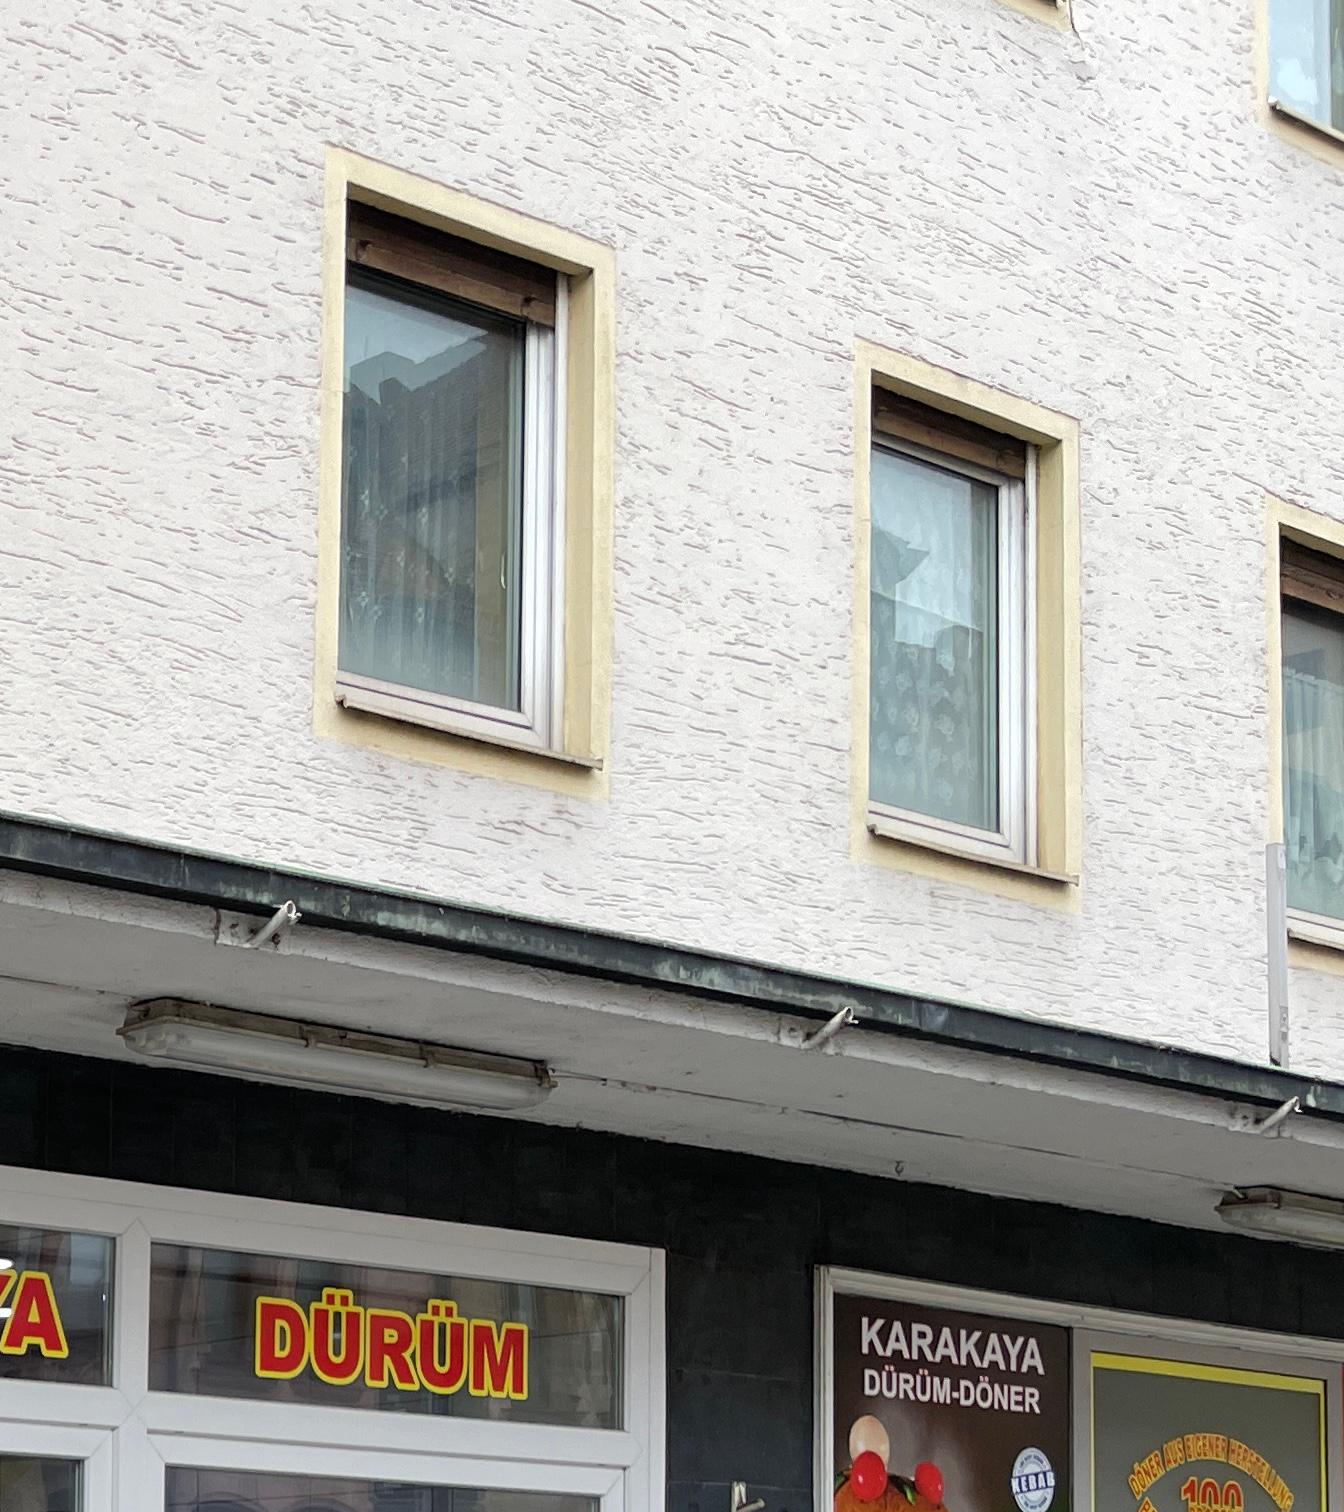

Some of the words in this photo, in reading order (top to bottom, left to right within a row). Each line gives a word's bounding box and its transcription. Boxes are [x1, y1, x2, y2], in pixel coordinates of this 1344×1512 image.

[255, 1287, 528, 1400] DÜRÜM
[861, 1316, 1045, 1375] KARAKAYA
[864, 1365, 1040, 1414] DÜRÜM-DÖNER
[1011, 1472, 1055, 1494] KEBAB
[1128, 1451, 1165, 1500] DÖNER
[1163, 1437, 1185, 1471] AUS
[1184, 1433, 1228, 1462] EIGENER
[1181, 1476, 1243, 1508] 100
